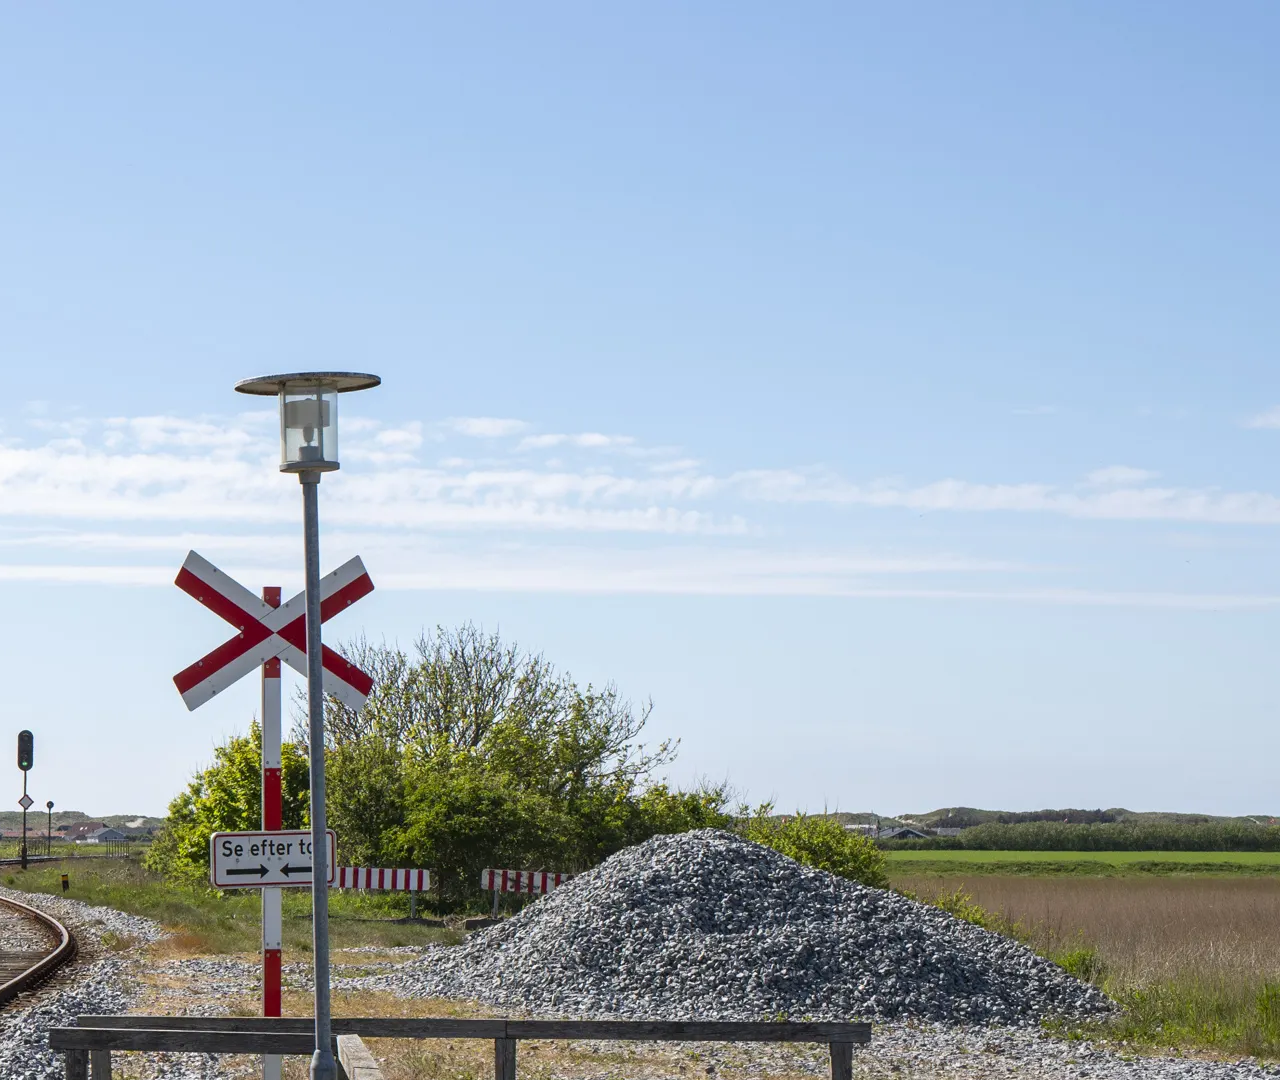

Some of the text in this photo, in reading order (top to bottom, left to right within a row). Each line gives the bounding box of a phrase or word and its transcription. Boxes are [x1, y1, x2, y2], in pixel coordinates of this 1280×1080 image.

[222, 839, 312, 857] Se efter to
